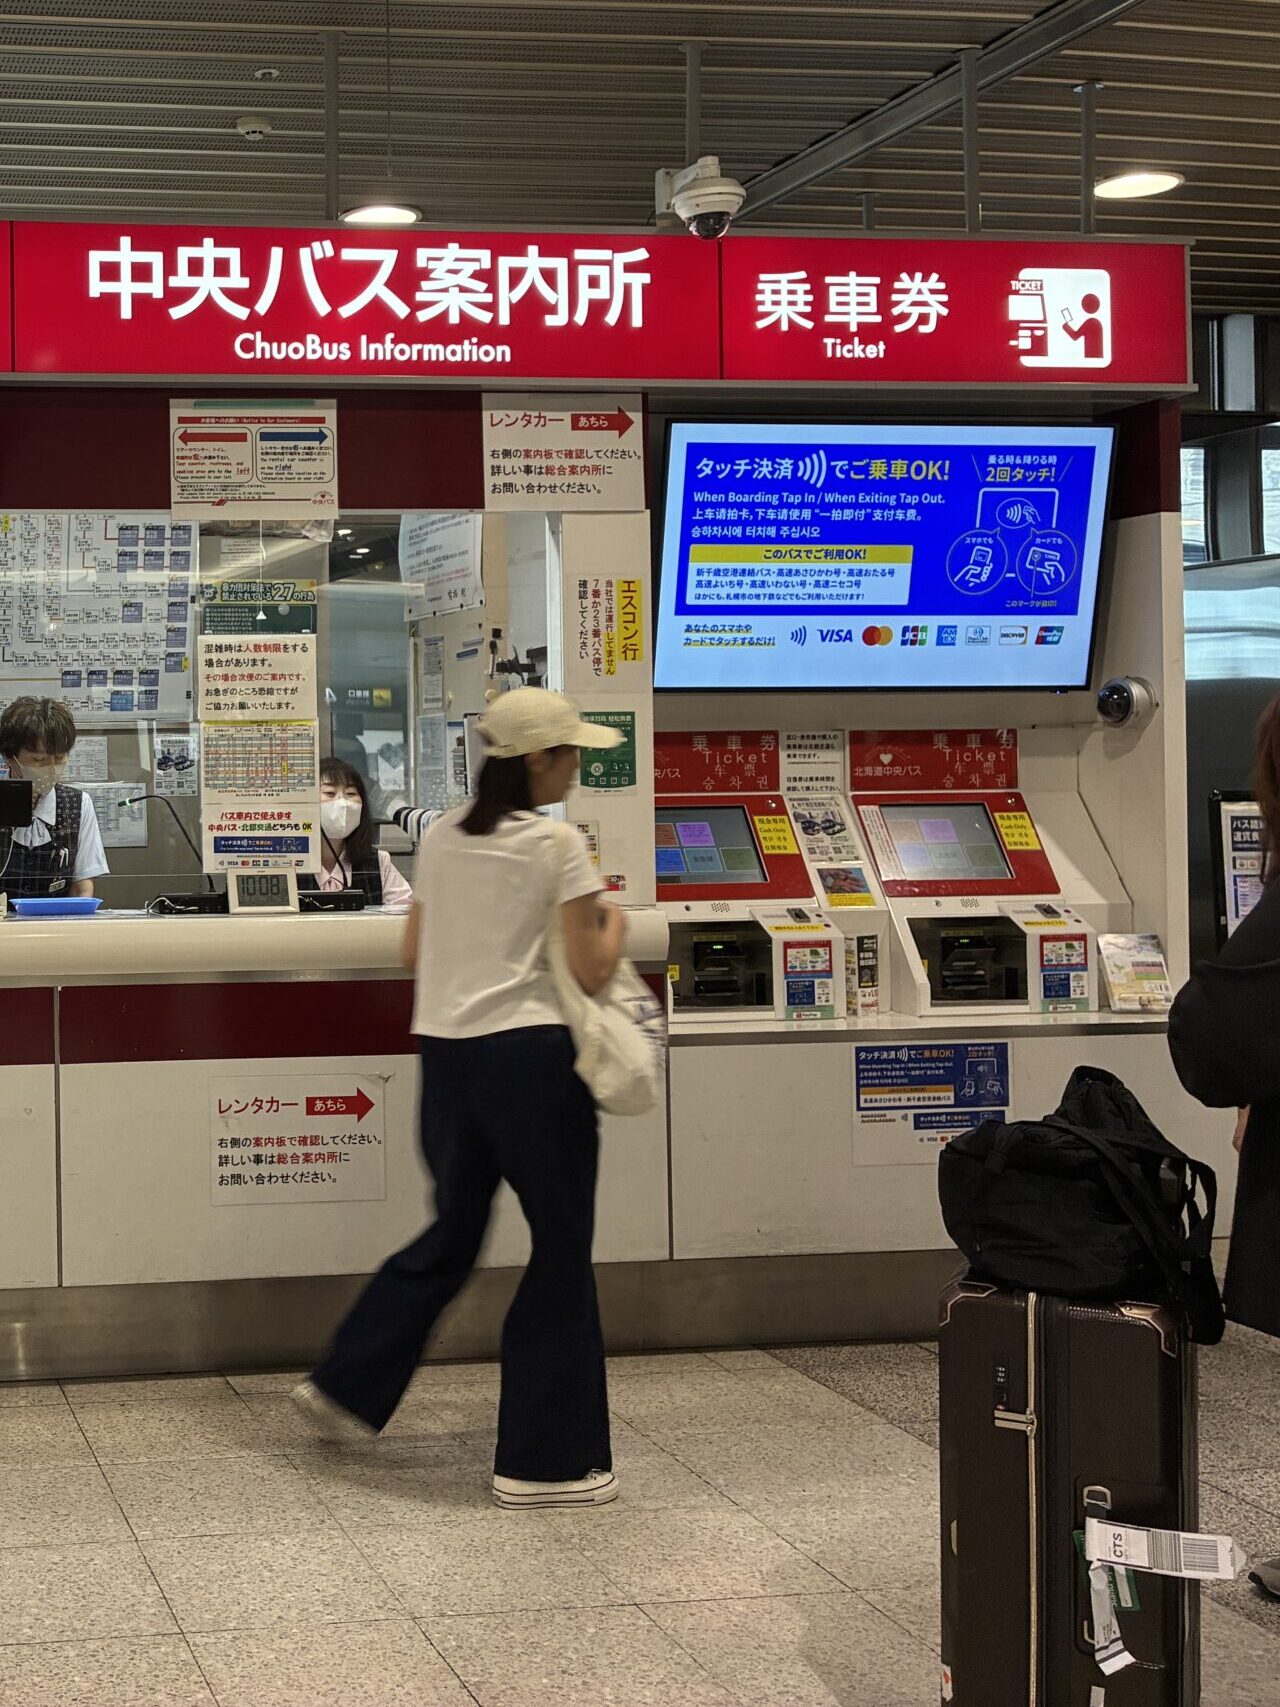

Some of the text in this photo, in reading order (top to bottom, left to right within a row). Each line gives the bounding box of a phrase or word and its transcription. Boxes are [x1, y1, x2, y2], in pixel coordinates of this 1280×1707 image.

[88, 236, 651, 327] 中央バス案内所
[1010, 280, 1041, 291] TICKET
[755, 270, 949, 334] 乗車券
[234, 333, 510, 362] ChuoBus Information
[823, 338, 886, 359] Ticket
[490, 412, 608, 428] レンタカー あちら
[696, 458, 950, 480] タッチ決済 でご乗車OK!
[986, 467, 1055, 482] 2回タッチ!
[694, 492, 945, 506] When Boarding Tap In When Exiting Tap Out.
[764, 549, 866, 560] このバスでご利用OK!
[622, 580, 638, 661] エスコン行
[817, 629, 853, 643] VISA
[205, 658, 272, 668] 場合があります。
[703, 751, 767, 764] Ticket
[944, 750, 1006, 762] Ticket
[303, 823, 312, 831] OK
[219, 1096, 346, 1115] レンタカー あちら
[1113, 1533, 1123, 1558] CTS
